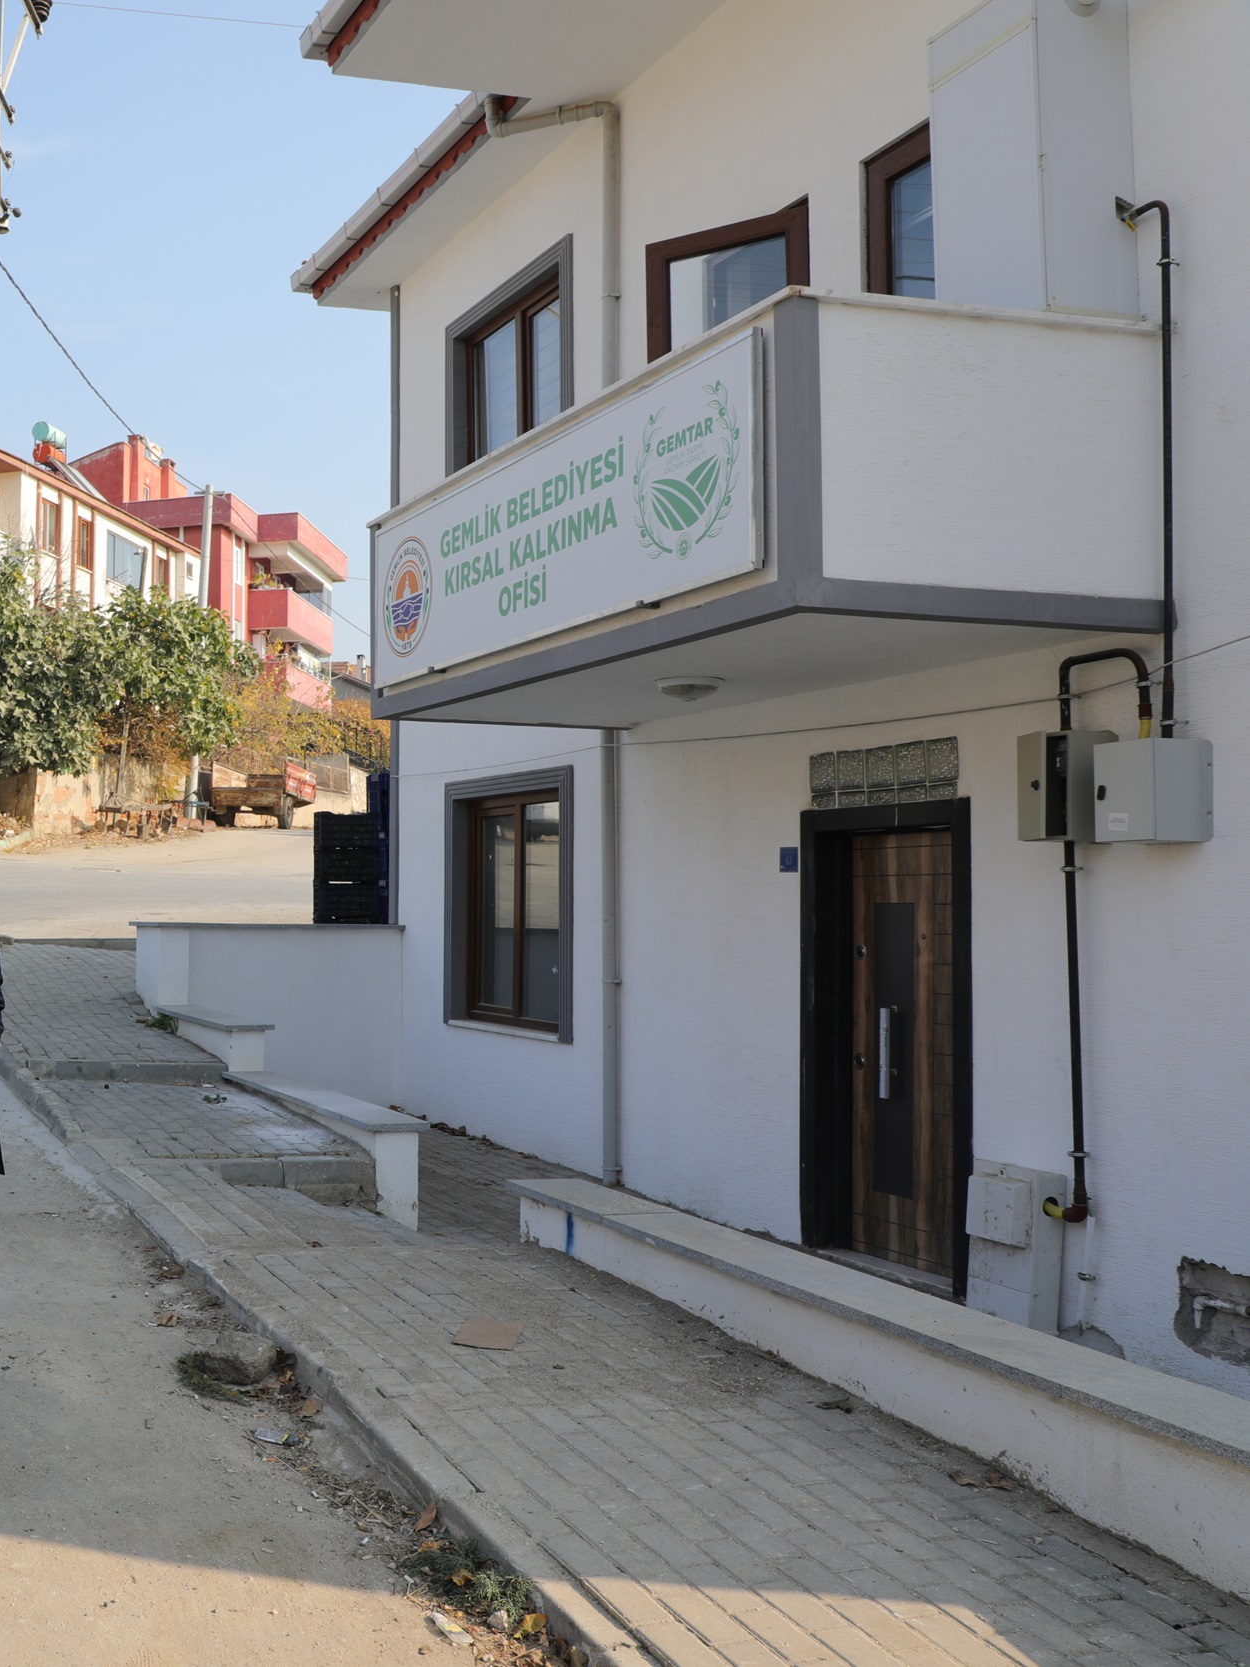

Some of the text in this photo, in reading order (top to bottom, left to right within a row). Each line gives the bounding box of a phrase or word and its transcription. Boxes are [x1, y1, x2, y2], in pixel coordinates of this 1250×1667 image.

[656, 416, 714, 457] GEMTAR
[440, 435, 624, 558] GEMLİK BELEDİYESİ
[445, 496, 618, 597] KIRSAL KALKINMA
[498, 564, 547, 617] OFİSİ
